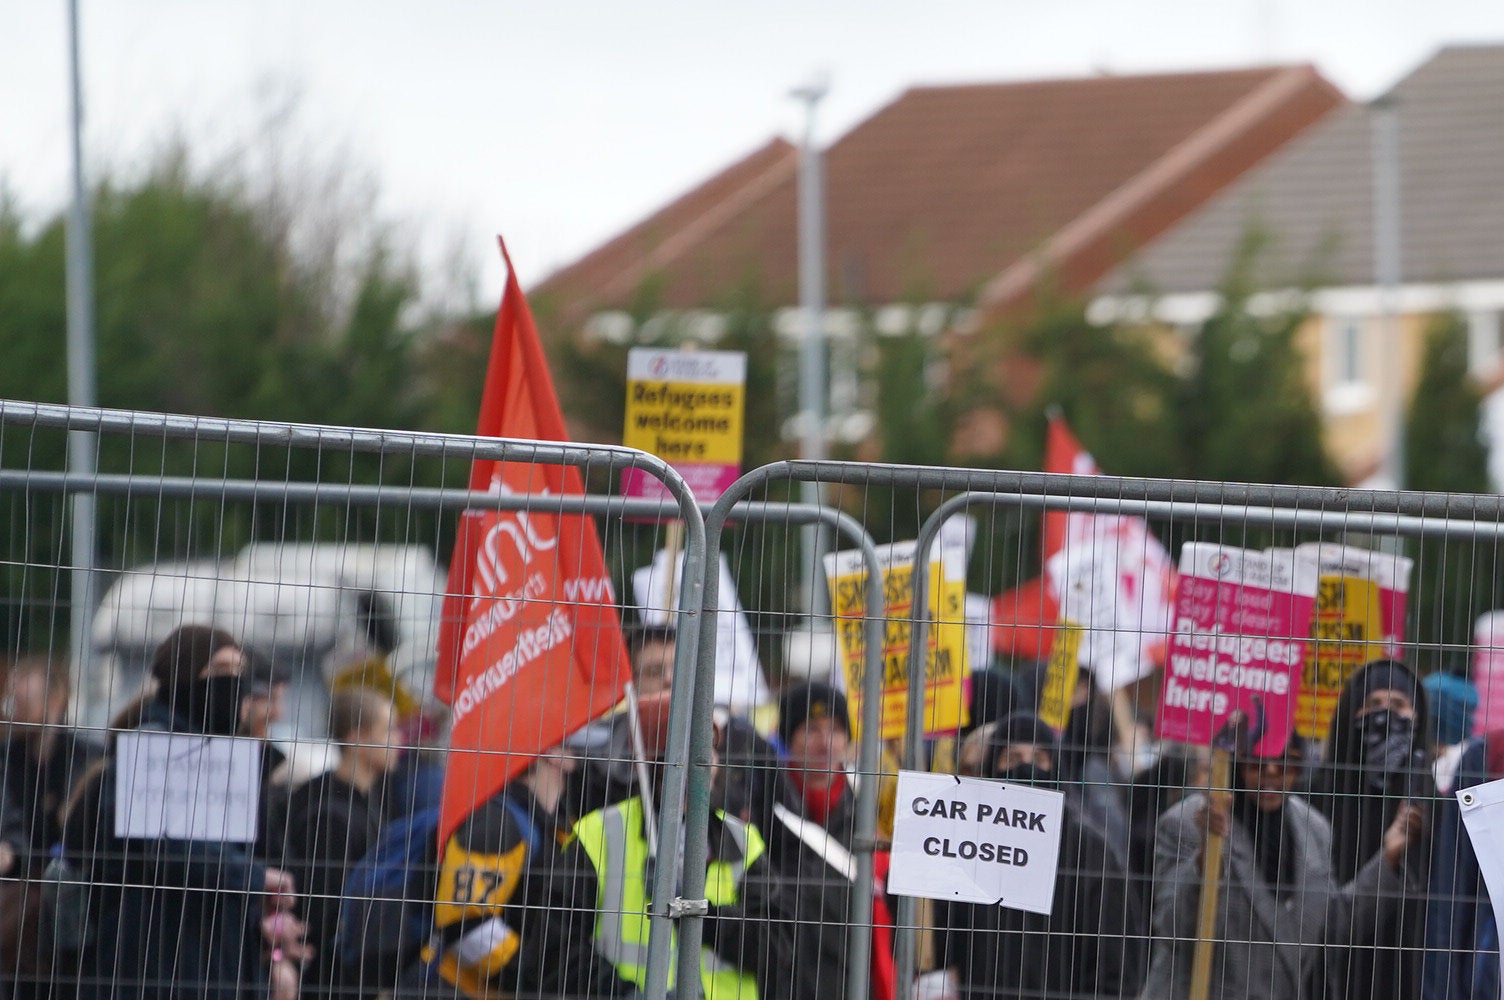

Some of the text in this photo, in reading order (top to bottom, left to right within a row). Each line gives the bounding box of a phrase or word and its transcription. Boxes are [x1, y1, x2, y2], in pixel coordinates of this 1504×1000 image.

[634, 384, 732, 409] Refugees
[636, 413, 730, 432] welcome
[656, 435, 706, 455] here
[1174, 617, 1300, 666] Refugees
[1171, 652, 1290, 695] welcome
[1166, 678, 1228, 715] here
[912, 797, 1047, 833] CAR PARK
[923, 837, 1029, 867] CLOSED
